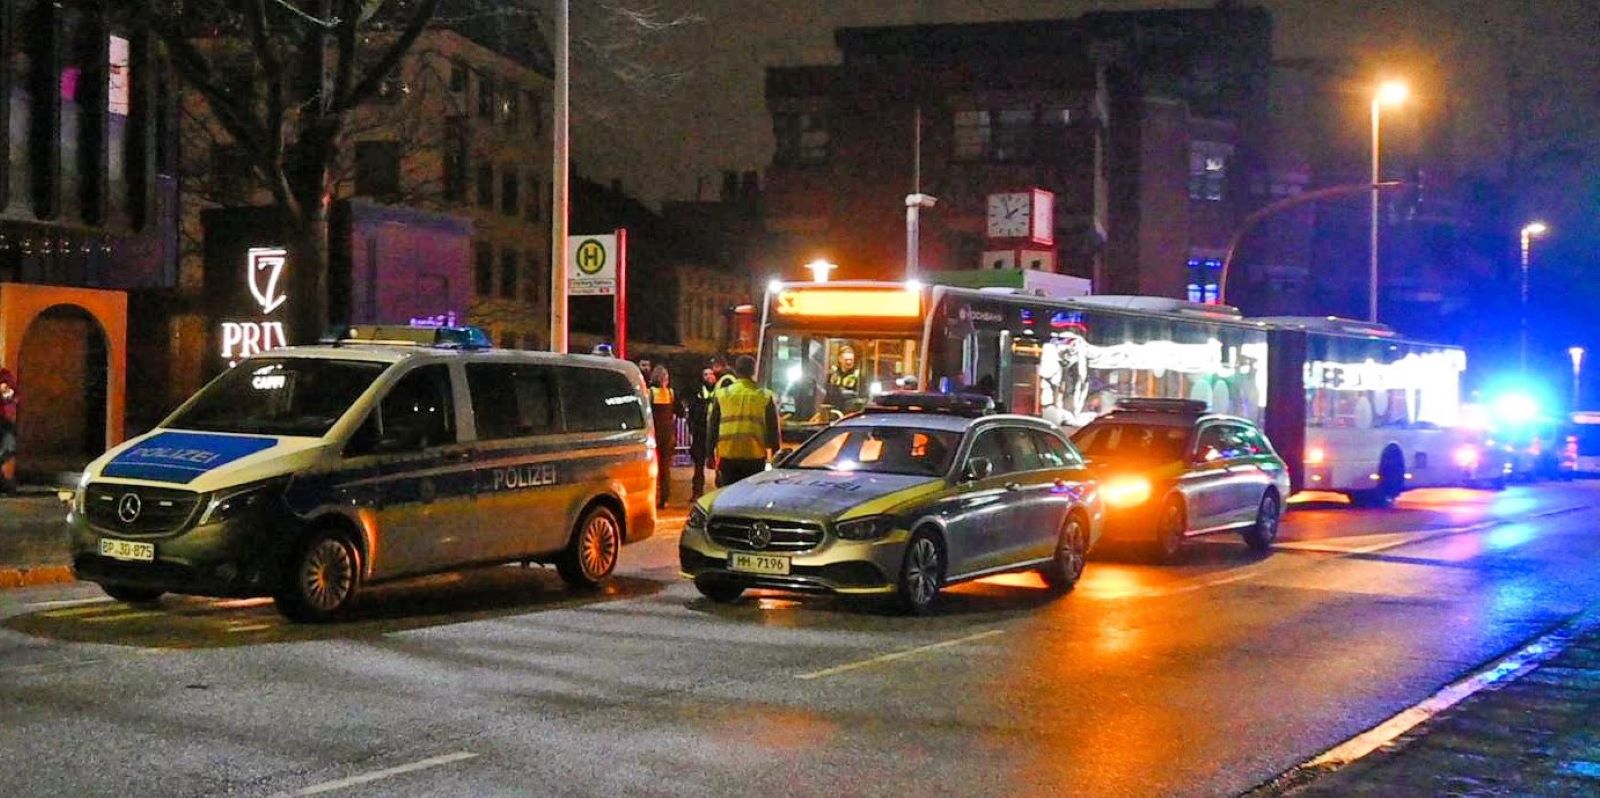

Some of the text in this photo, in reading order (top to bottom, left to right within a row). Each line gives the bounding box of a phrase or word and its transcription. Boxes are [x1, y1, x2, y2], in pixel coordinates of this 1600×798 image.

[126, 447, 220, 463] POLIZEI
[493, 464, 557, 489] POLIZEI
[756, 557, 784, 571] 7196
